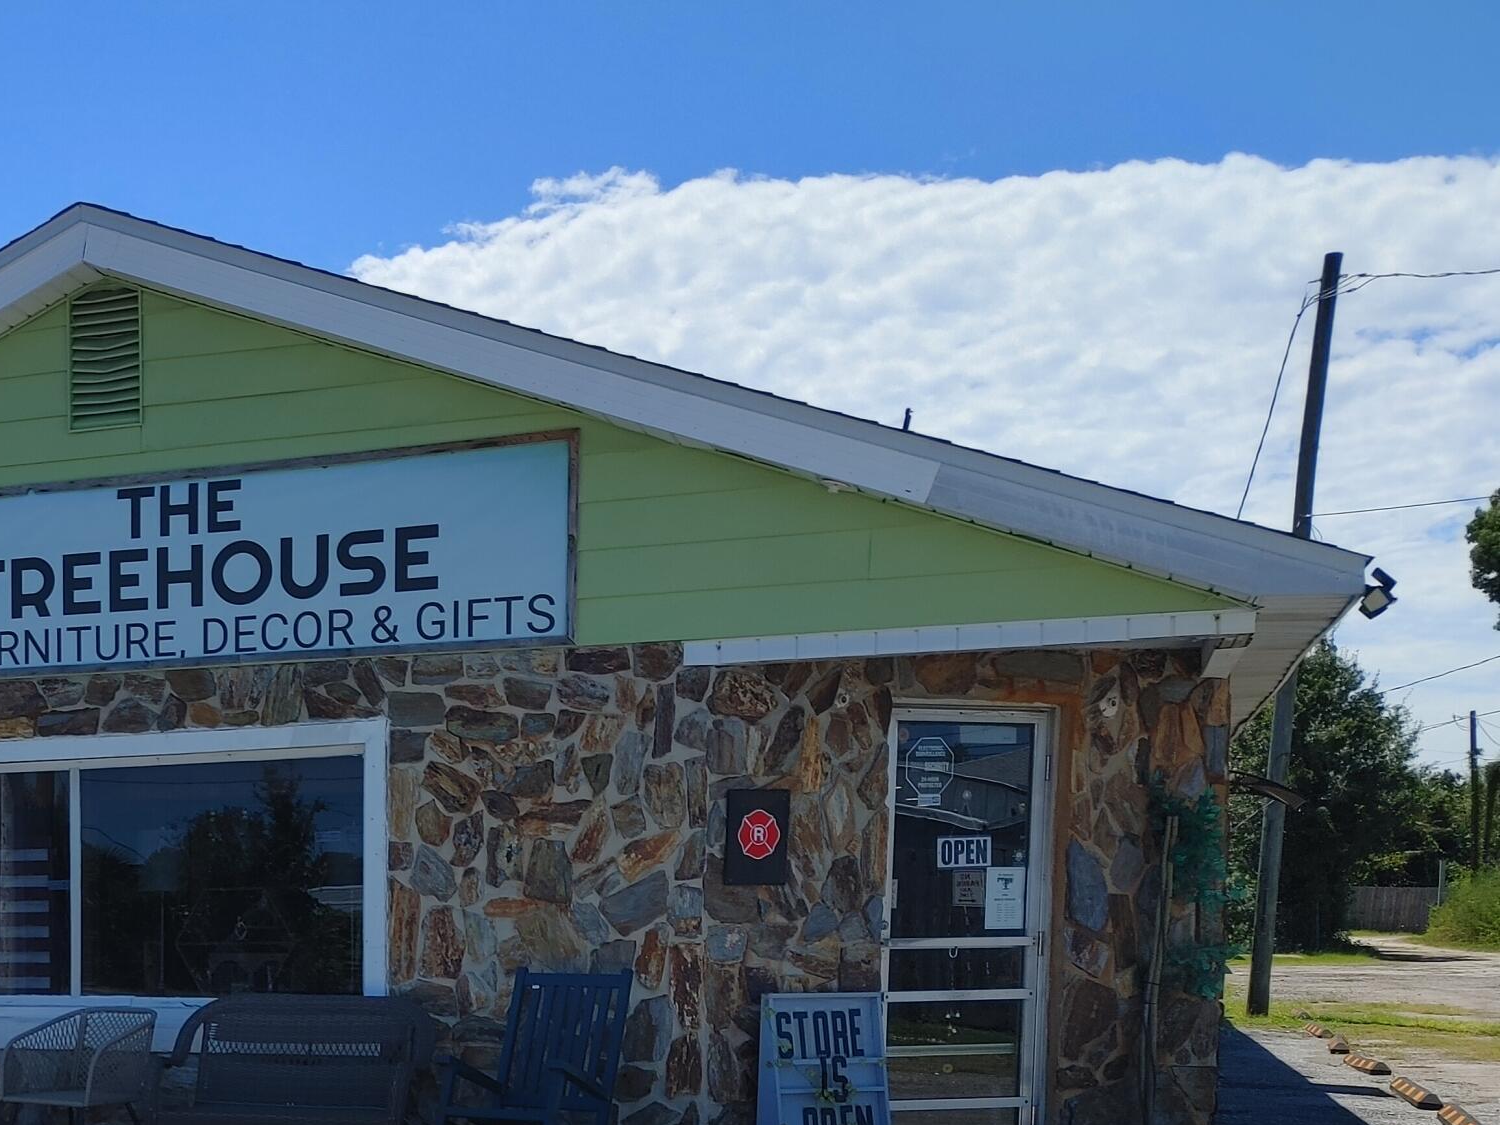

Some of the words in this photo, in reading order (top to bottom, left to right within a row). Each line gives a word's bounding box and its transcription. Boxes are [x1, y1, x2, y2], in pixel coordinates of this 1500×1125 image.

[117, 479, 242, 539] THE
[202, 608, 355, 655] DECOR
[370, 605, 400, 643] &
[415, 593, 557, 641] GIFTS
[753, 827, 764, 842] R
[941, 839, 987, 865] OPEN
[775, 1008, 864, 1059] STORE
[819, 1055, 849, 1103] IS
